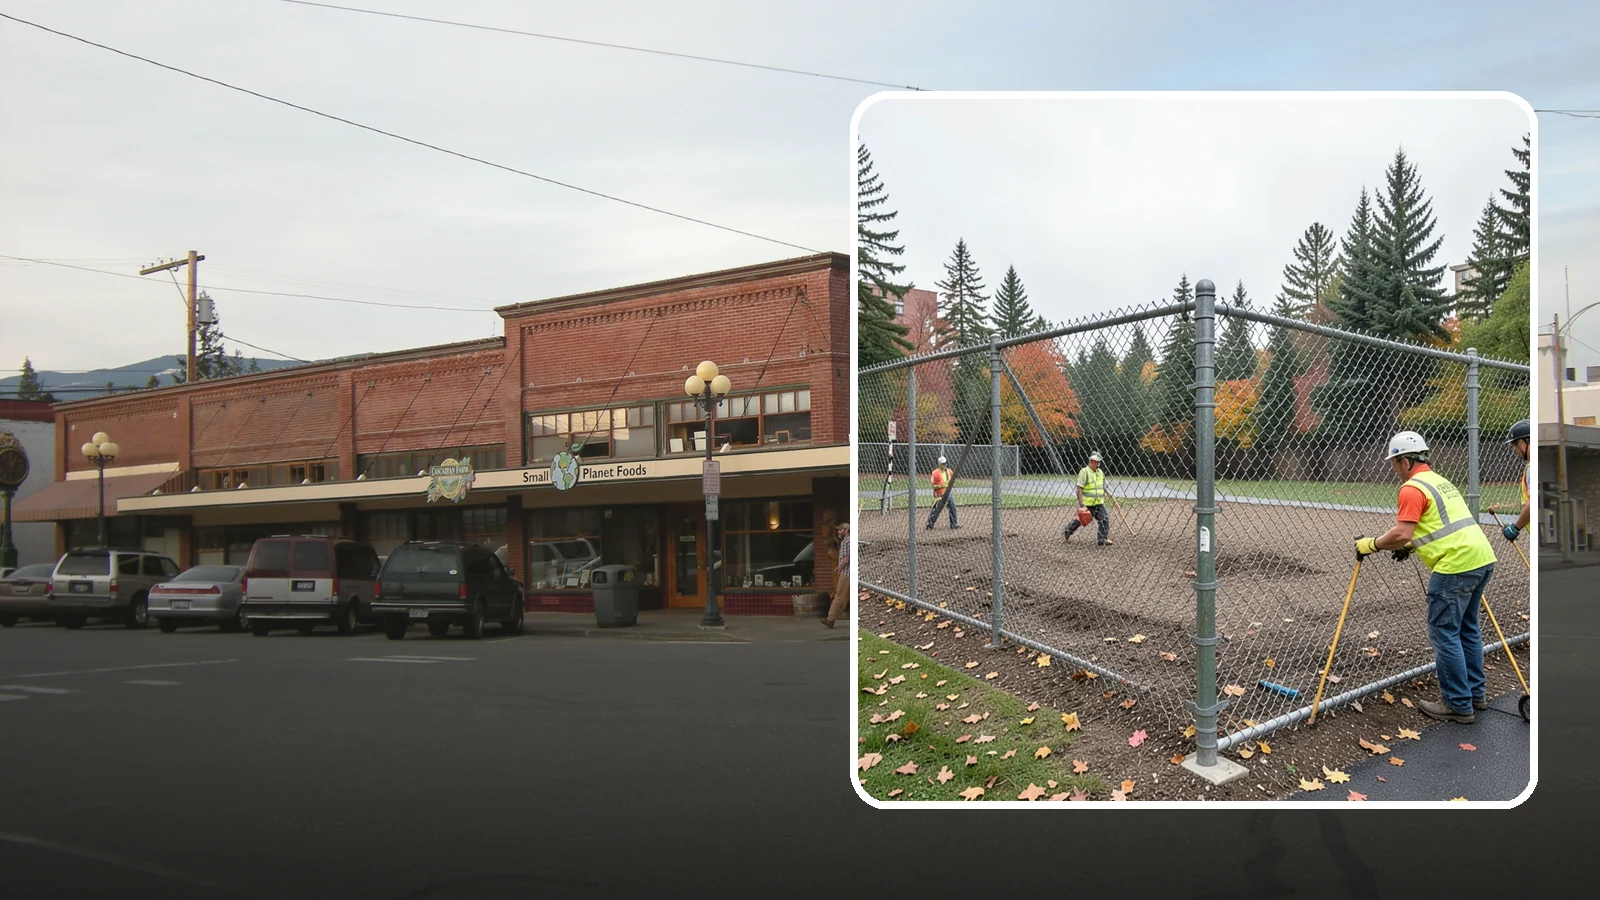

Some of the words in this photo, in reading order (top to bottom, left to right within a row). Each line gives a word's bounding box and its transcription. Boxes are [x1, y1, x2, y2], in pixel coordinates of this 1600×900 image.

[523, 471, 549, 483] Small
[582, 467, 614, 479] Planet
[616, 464, 647, 477] Foods
